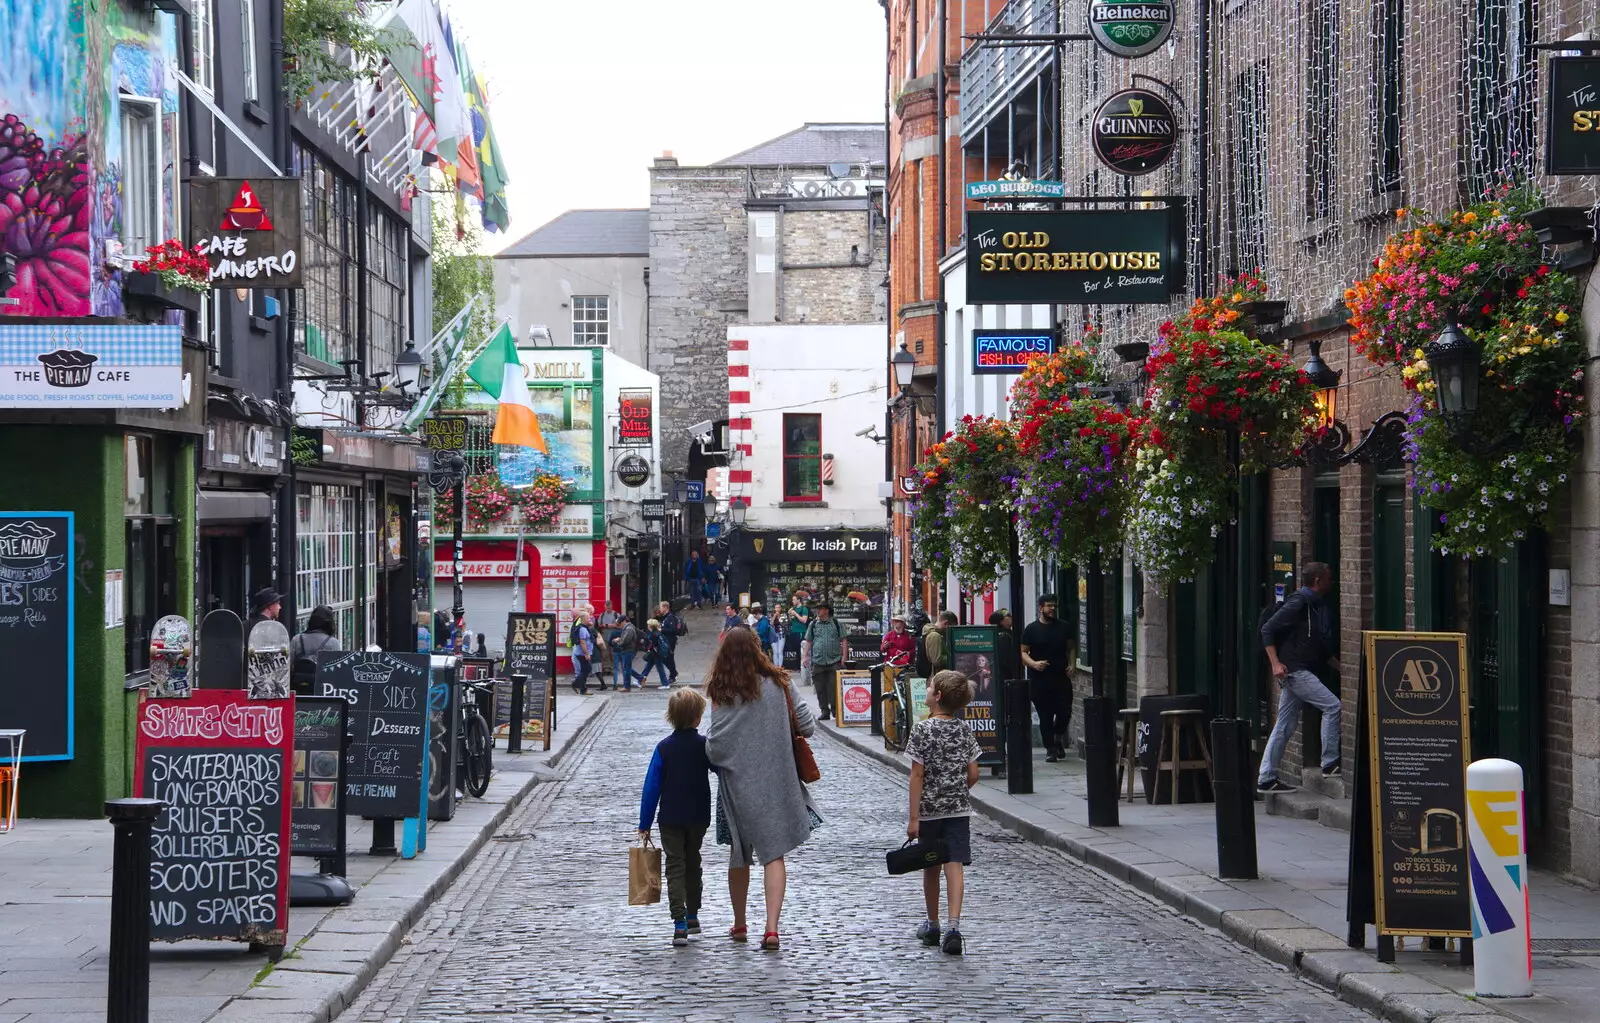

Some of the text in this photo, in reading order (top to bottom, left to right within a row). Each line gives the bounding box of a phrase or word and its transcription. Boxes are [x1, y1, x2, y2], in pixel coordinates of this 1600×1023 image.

[1096, 6, 1168, 20] Heineken
[1567, 84, 1597, 107] The
[1100, 117, 1171, 134] GUINNESS
[971, 182, 1062, 195] LEO BURDOCK
[197, 235, 248, 257] CAFE
[973, 229, 1050, 249] The OLD
[208, 249, 296, 282] MINEIRO
[980, 252, 1161, 271] STOREHOUSE
[1083, 275, 1165, 293] Bar & Restaurant
[979, 339, 1047, 351] FAMOUS
[979, 353, 1003, 365] FISH
[14, 367, 130, 385] THE PIEMAN CAFE
[533, 362, 585, 379] MILL
[622, 406, 649, 418] OLD
[424, 420, 466, 435] BAD
[622, 419, 650, 431] MILL
[428, 435, 465, 449] ASS
[777, 537, 806, 551] The
[812, 538, 846, 551] Irish
[461, 564, 492, 574] TAKE
[496, 564, 515, 574] OU
[32, 587, 58, 602] SIDES
[515, 618, 551, 632] BAD
[512, 631, 548, 645] ASS
[355, 673, 384, 681] PIEMAN
[1394, 659, 1442, 692] AB
[383, 685, 416, 709] SIDES
[964, 707, 990, 719] LIVE
[141, 703, 222, 739] SKATE
[221, 702, 284, 746] CITY
[968, 719, 996, 731] USIC
[368, 746, 400, 763] Craft
[151, 753, 282, 782] SKATEBOARDS
[373, 760, 401, 774] Beer
[153, 780, 279, 805] LONGBOARDS
[363, 784, 397, 798] PIEMAN
[151, 832, 280, 859] ROLLERBLADES
[1393, 862, 1458, 873] 087 361 5874
[150, 858, 278, 893] SCOOTERS
[197, 894, 276, 925] SPARES
